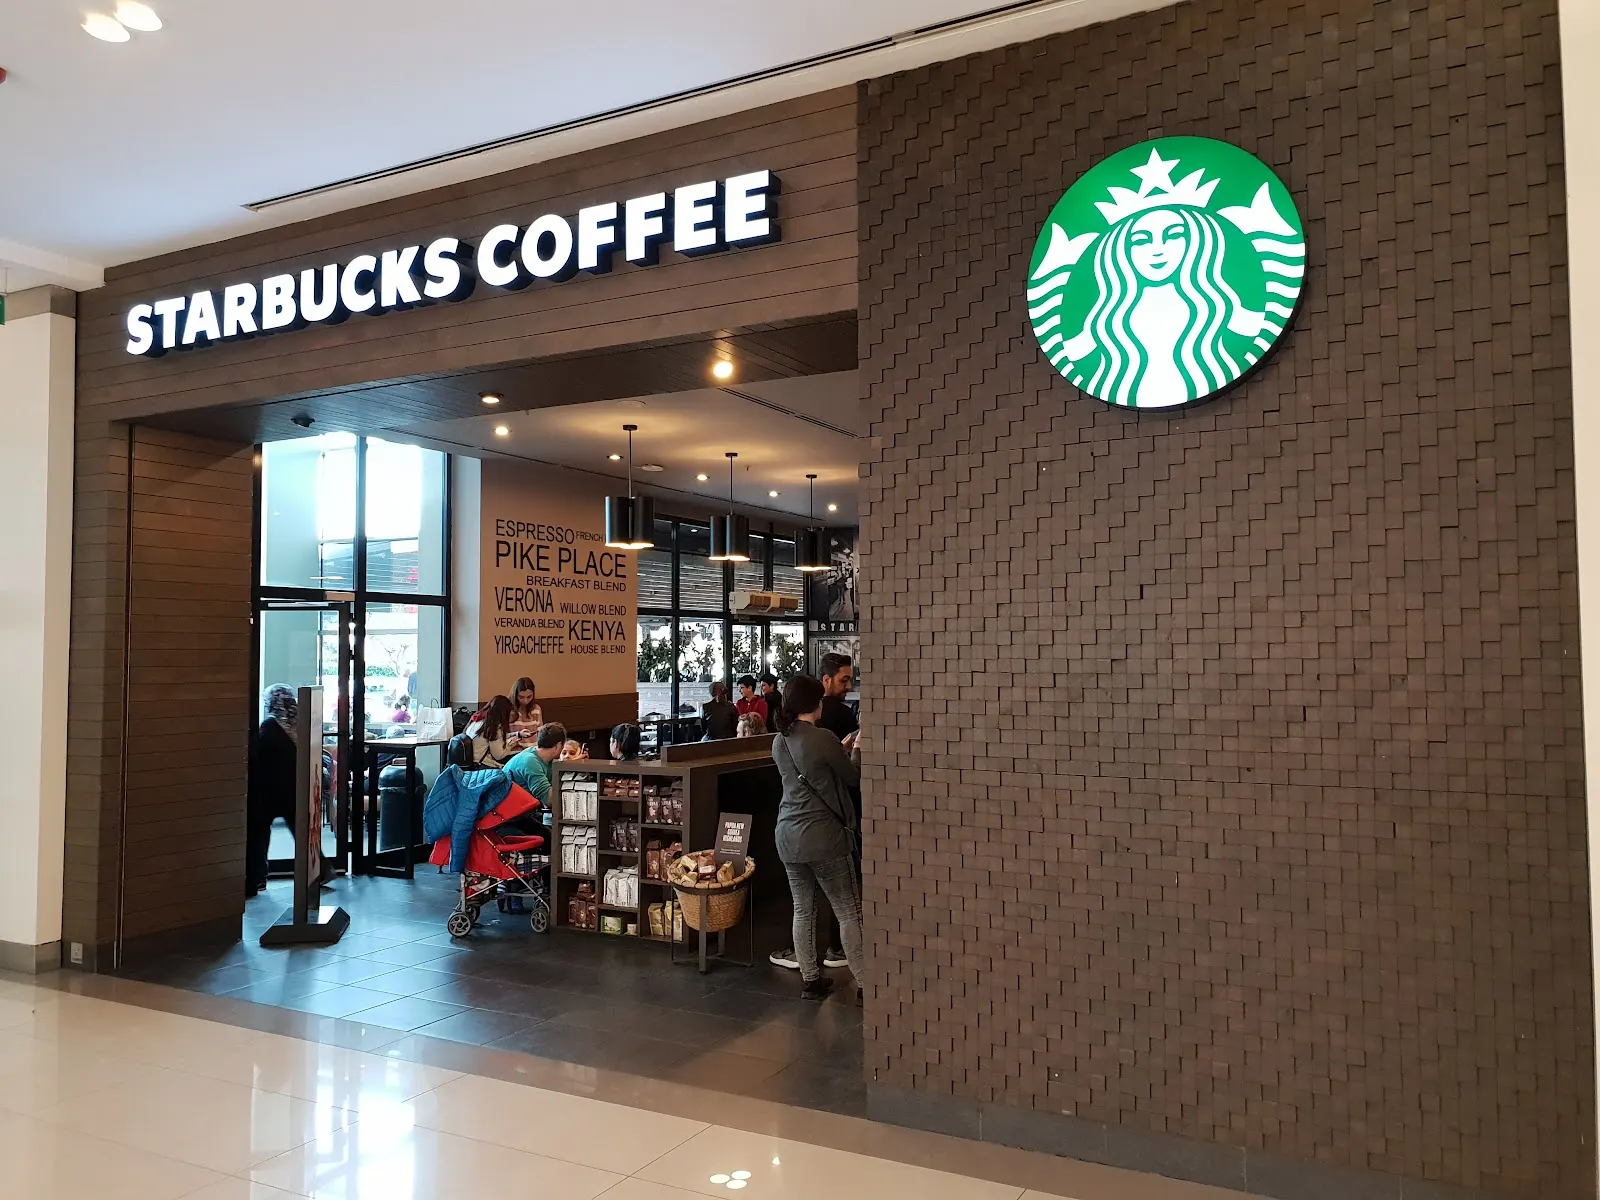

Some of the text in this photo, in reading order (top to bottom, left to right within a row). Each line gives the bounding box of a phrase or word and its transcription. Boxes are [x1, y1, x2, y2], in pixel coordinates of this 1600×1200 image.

[126, 169, 773, 356] STARBUCKS COFFEE
[495, 519, 604, 545] ESPRESSO FRENCH
[495, 540, 627, 579] PIKE PLACE
[526, 575, 627, 592] BREAKFAST BLEND
[495, 586, 554, 613] VERONA
[560, 602, 627, 616] WILLOW BLEND
[494, 617, 565, 629] VERANDA BLEND
[567, 619, 626, 641] KENYA
[494, 635, 565, 655] YIRGACHEFFE
[570, 644, 626, 654] HOUSE BLEND
